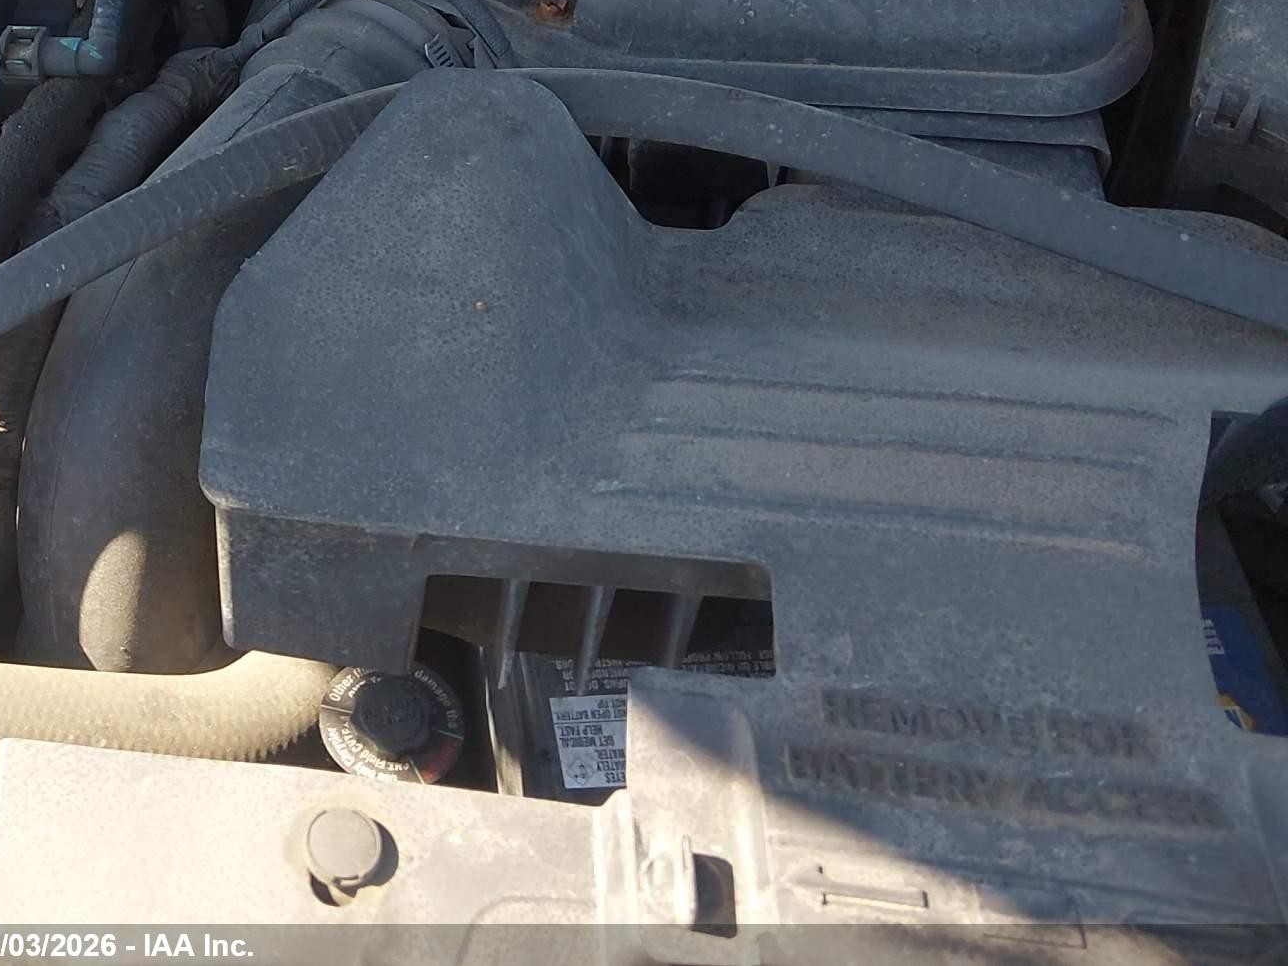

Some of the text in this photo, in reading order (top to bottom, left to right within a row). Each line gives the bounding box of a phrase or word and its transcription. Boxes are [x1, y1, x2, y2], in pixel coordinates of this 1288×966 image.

[328, 674, 354, 702] Other
[557, 725, 603, 736] HELP FAST.
[821, 688, 1038, 749] REMOVE
[786, 742, 1001, 810] BATTERY
